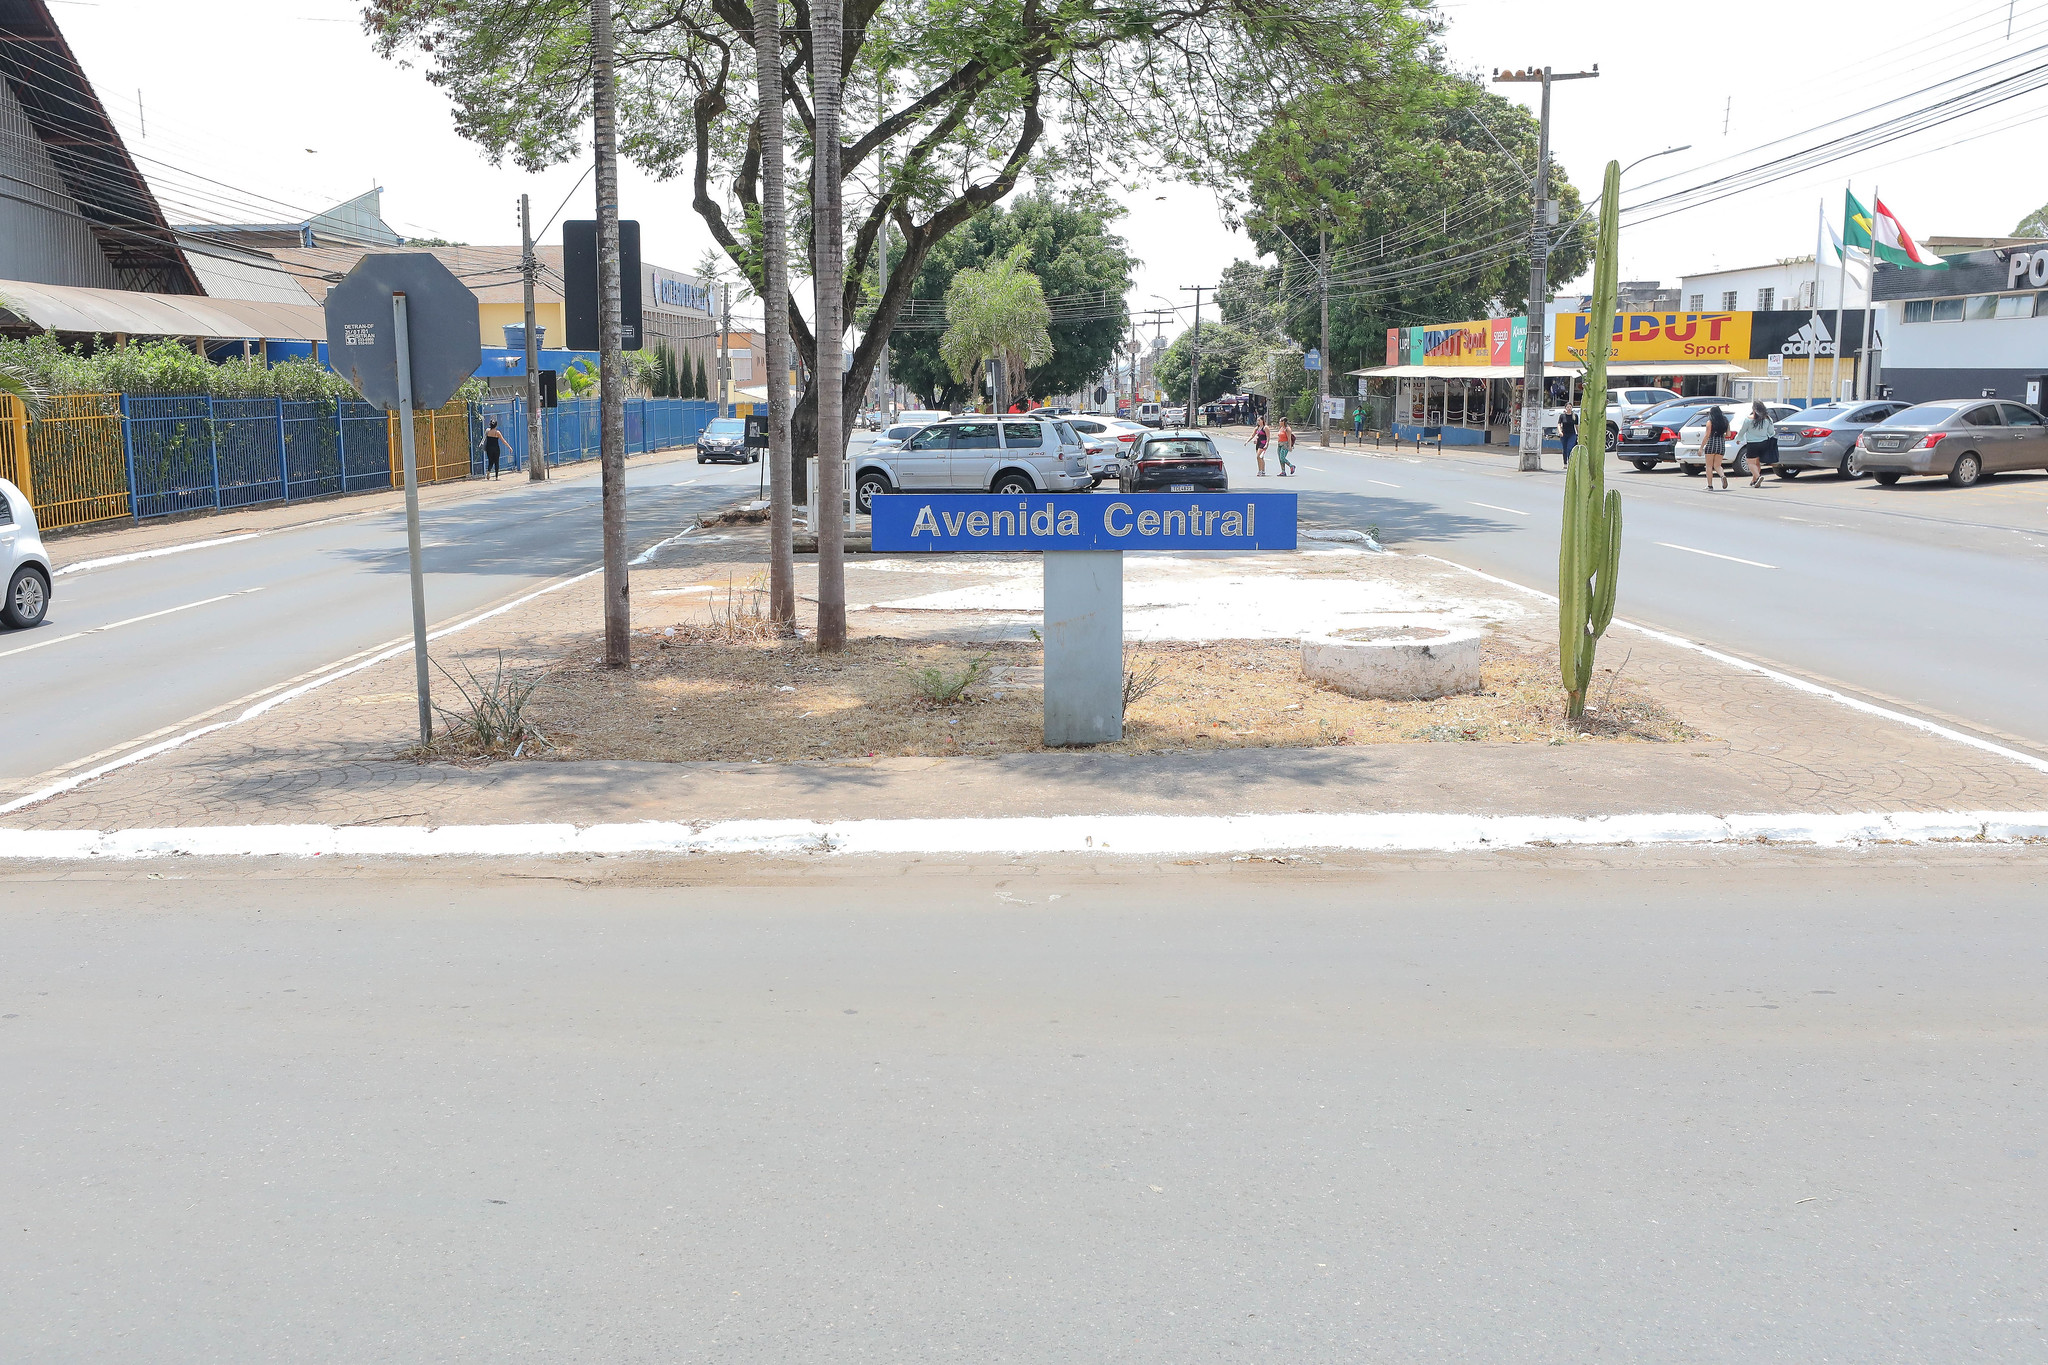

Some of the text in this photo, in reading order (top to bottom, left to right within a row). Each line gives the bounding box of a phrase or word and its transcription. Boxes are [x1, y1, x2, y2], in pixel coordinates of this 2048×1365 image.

[1423, 327, 1487, 357] KIDUT Sport
[1493, 328, 1509, 342] speedo
[1683, 343, 1730, 357] Sport
[911, 502, 1254, 538] Avenida Central
